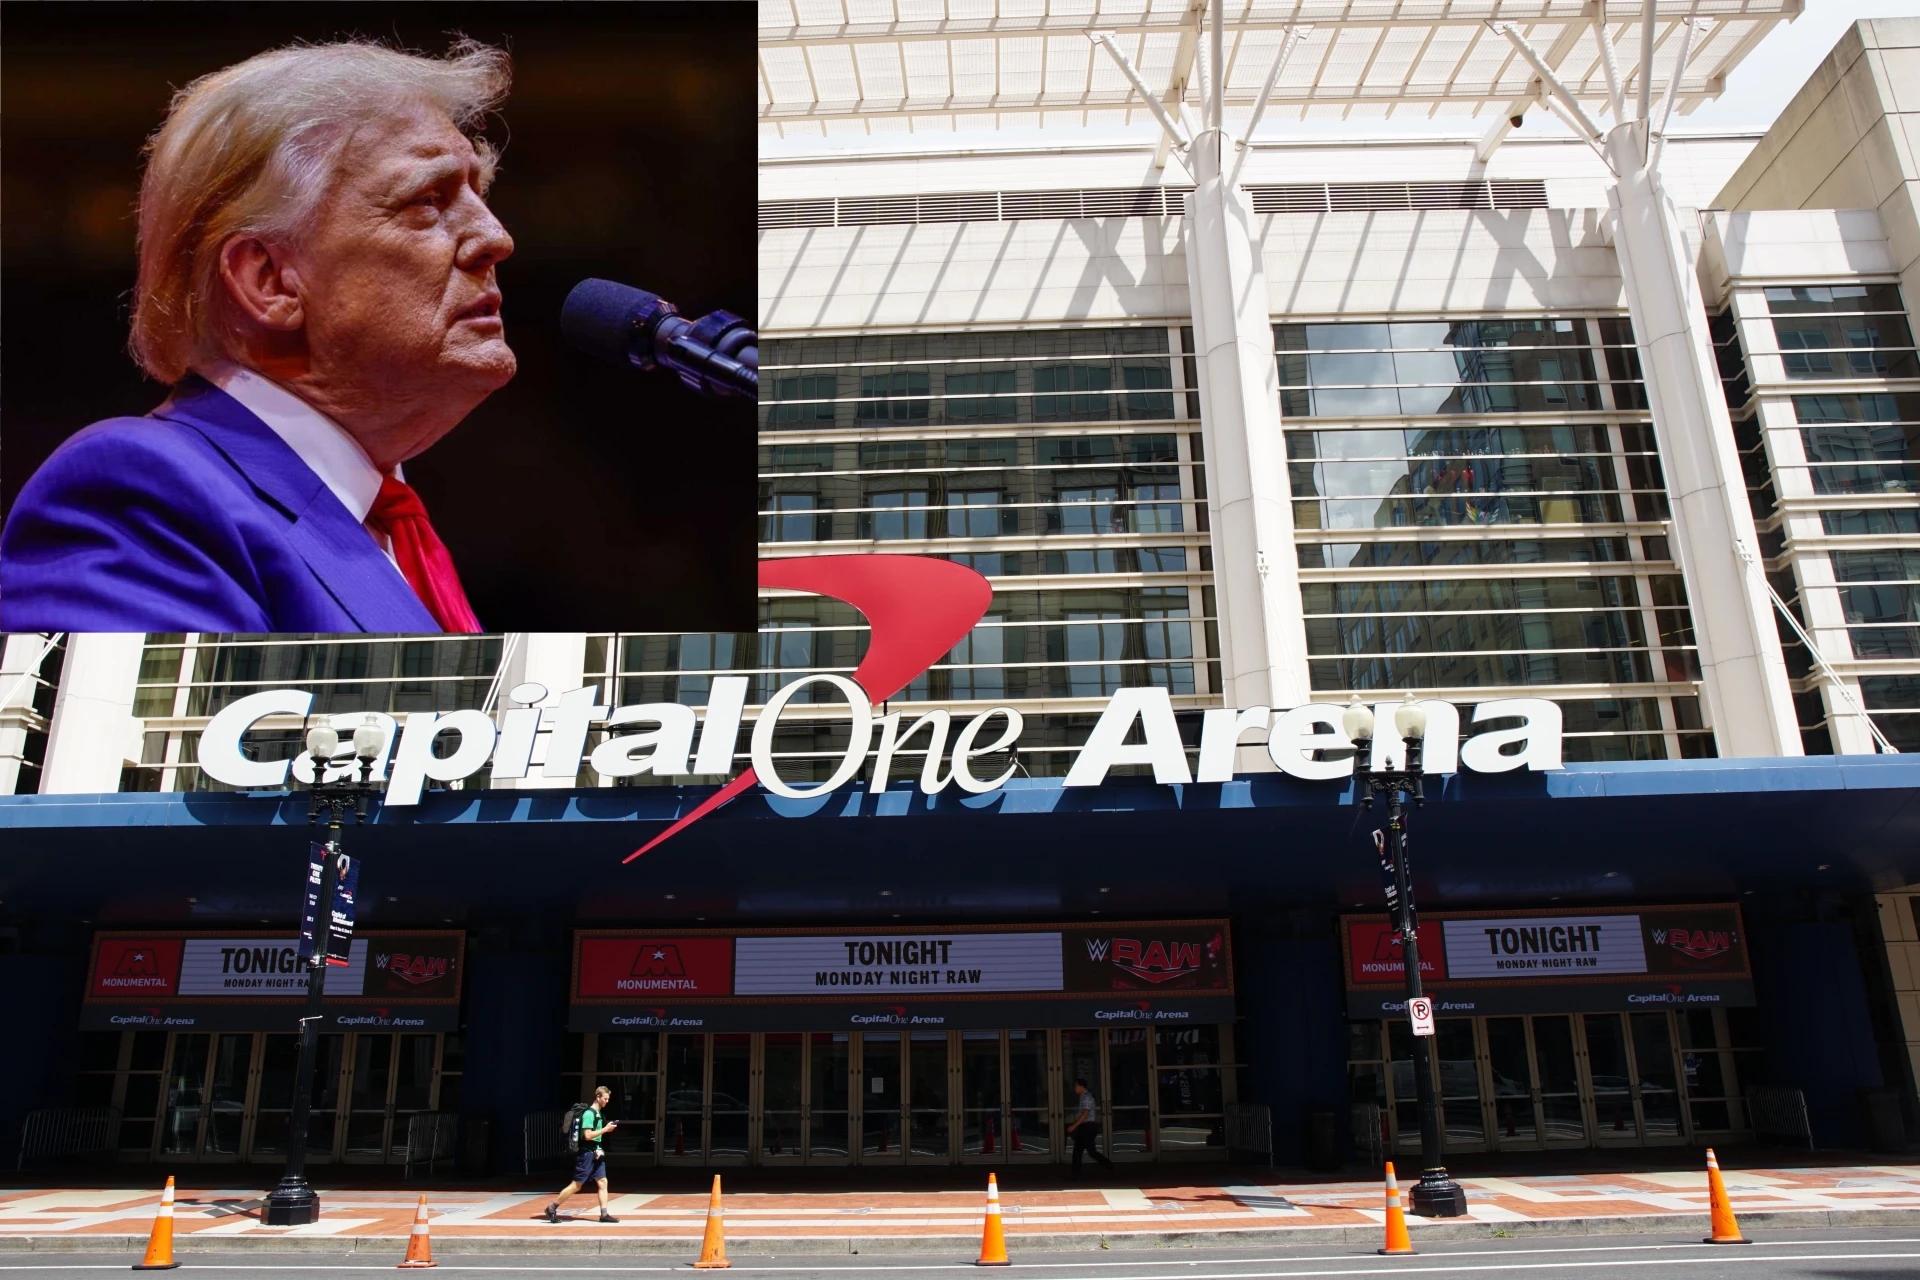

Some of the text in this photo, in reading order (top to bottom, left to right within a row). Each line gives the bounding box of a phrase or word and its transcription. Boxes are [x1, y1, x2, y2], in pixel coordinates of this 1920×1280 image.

[1062, 686, 1565, 785] Arena
[1485, 926, 1601, 954] TONIGHT
[1669, 929, 1730, 951] RAW
[845, 941, 952, 965] TONIGHT
[1112, 938, 1200, 971] RAW
[221, 947, 313, 974] TONIGH
[391, 953, 448, 976] RAW
[1497, 957, 1597, 969] MONDAY NIGHT RAW
[1362, 962, 1435, 973] MONUMTAL
[102, 978, 168, 987] MONUMENTAL
[816, 969, 981, 985] MONDAY NIGHT RAW
[224, 978, 310, 988] MONDAY NIGHT RA
[617, 979, 697, 990] MONUMENTAL
[1687, 994, 1720, 1002] Arena
[1442, 1002, 1475, 1010] Arena
[910, 1016, 945, 1024] Arena
[1155, 1010, 1189, 1019] Arena
[164, 1017, 195, 1025] Arena
[392, 1018, 425, 1026] Arena
[670, 1018, 703, 1026] Arena
